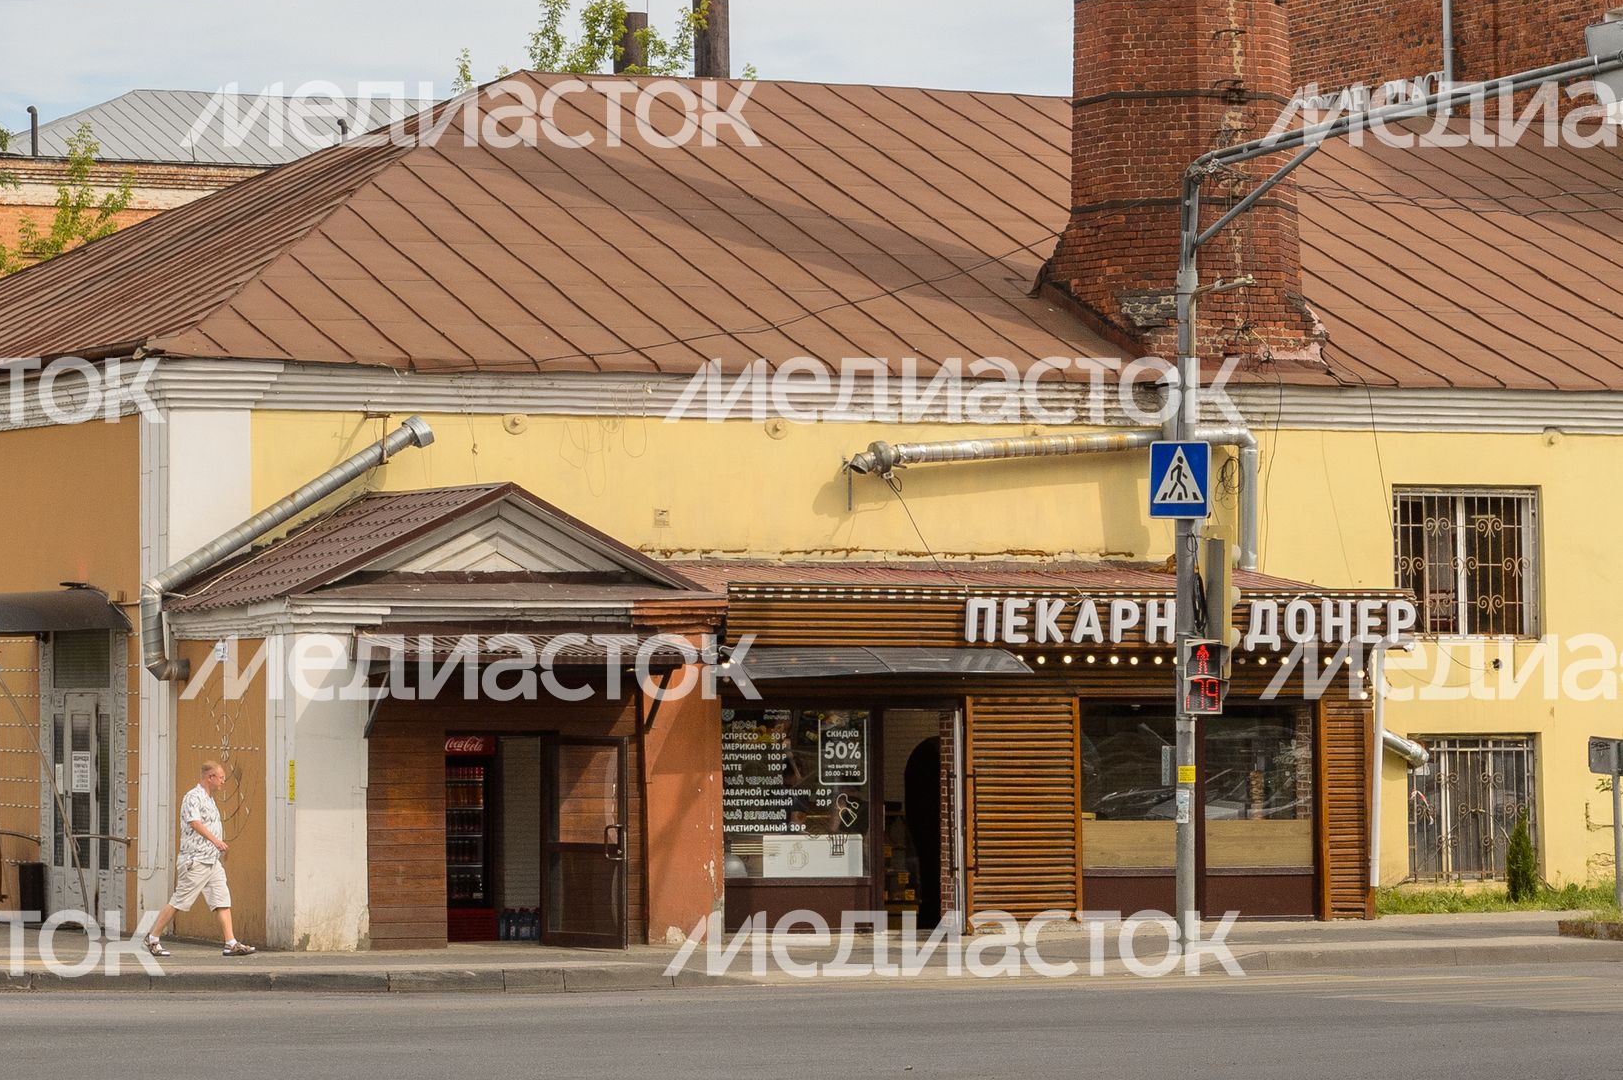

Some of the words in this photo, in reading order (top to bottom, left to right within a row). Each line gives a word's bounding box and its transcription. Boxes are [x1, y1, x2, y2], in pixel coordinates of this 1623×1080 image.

[964, 599, 1177, 644] ПЕКАРН
[1244, 600, 1416, 651] ДОНЕР
[771, 743, 780, 751] 70
[824, 741, 861, 759] 50%
[768, 763, 780, 771] 100
[816, 799, 825, 807] 30
[790, 824, 799, 832] 30
